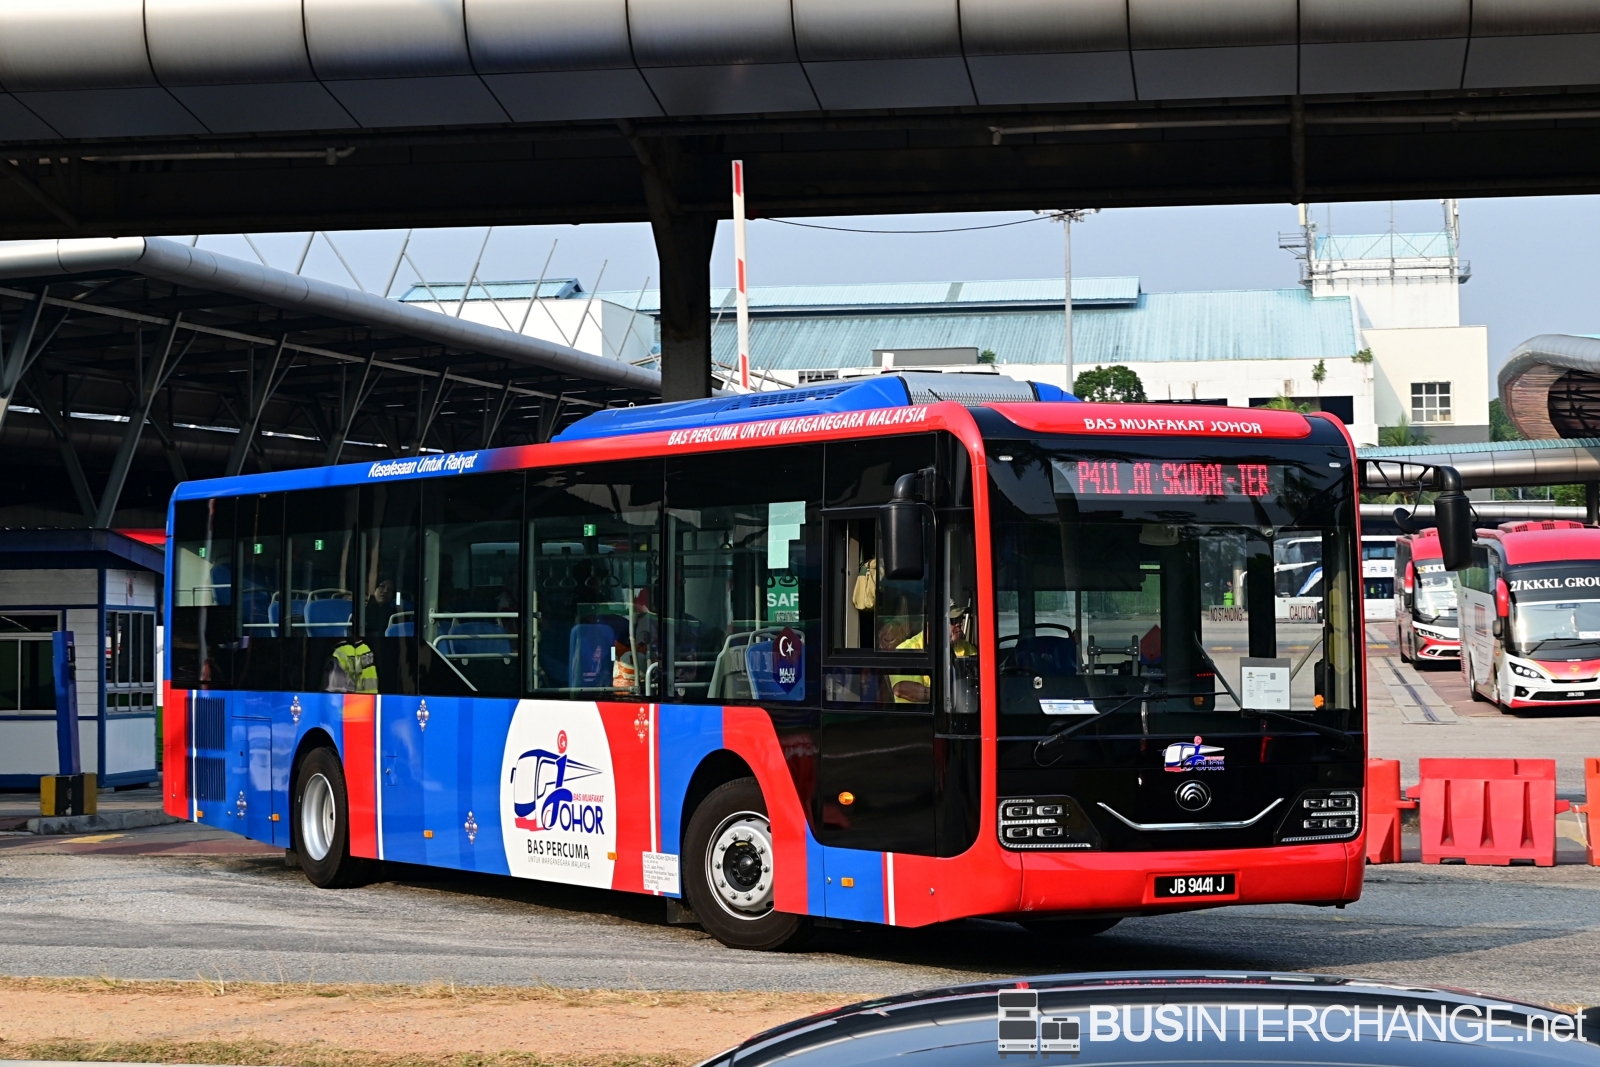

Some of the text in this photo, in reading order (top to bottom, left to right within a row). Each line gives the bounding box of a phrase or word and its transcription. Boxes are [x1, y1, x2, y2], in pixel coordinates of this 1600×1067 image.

[668, 406, 927, 446] BAS PERCUMA UNTUK WARGANEGARA MALAYSIA
[1083, 418, 1263, 434] BAS MUAFAKAT JOHOR
[368, 452, 478, 478] Keselesaan Untuk Rakyat
[1077, 461, 1121, 494] P411
[1161, 463, 1223, 496] SKUDAI
[1217, 606, 1243, 622] STANDING
[1289, 605, 1317, 621] CAUTION
[779, 667, 796, 677] MAJU
[779, 676, 796, 684] JOHOR
[573, 793, 605, 803] BAS MUAFAKAT
[527, 838, 590, 860] BAS PERCUMA
[528, 855, 541, 864] UNTUK
[571, 859, 591, 869] MALAYSIA
[1169, 876, 1225, 894] JB 9441 J
